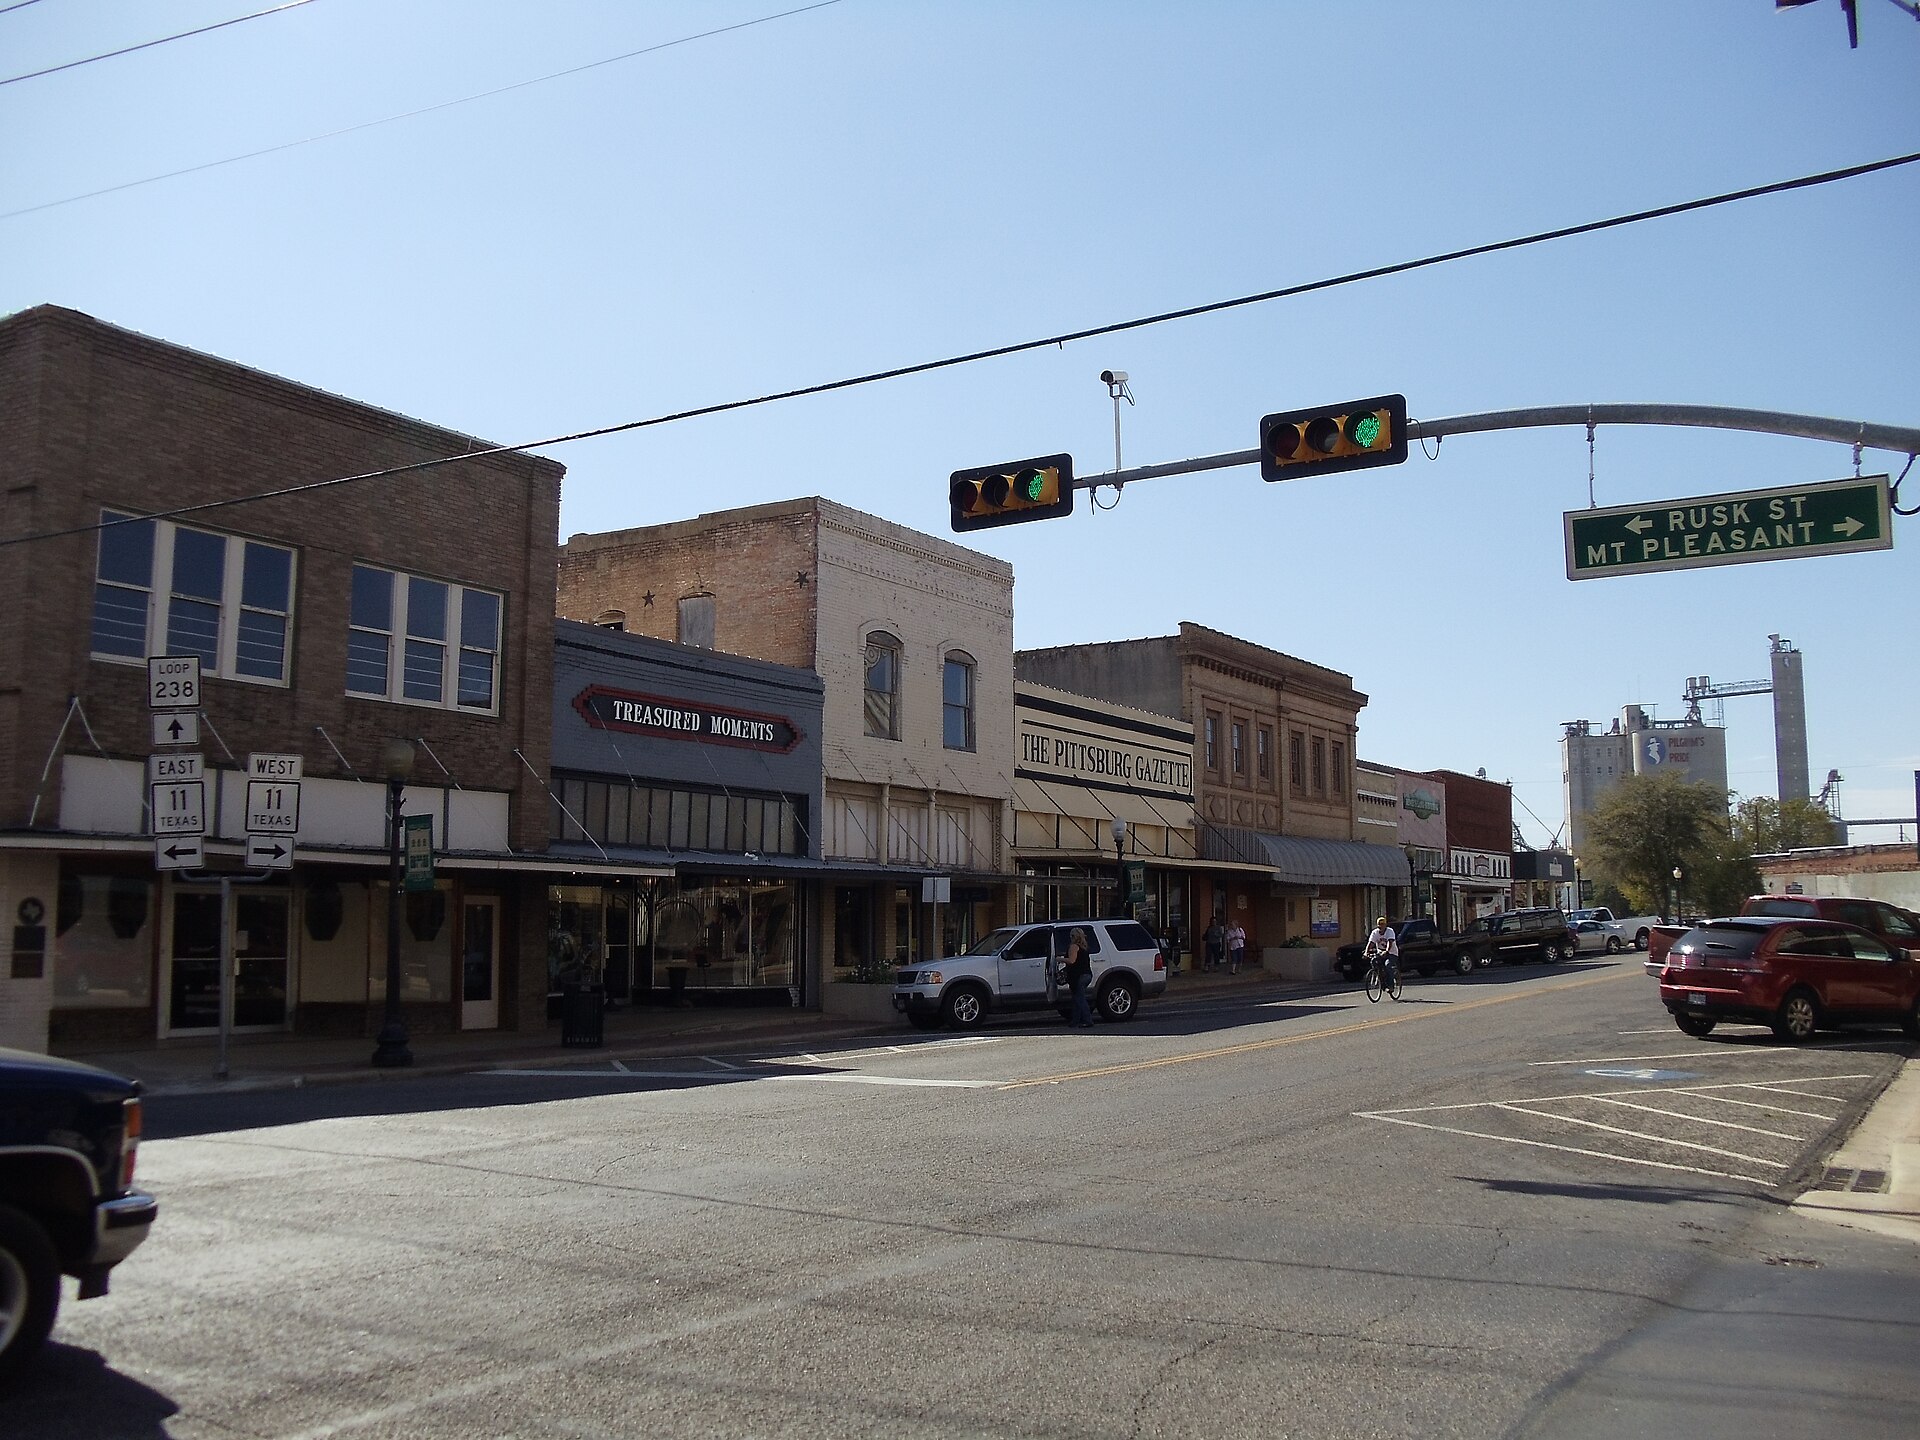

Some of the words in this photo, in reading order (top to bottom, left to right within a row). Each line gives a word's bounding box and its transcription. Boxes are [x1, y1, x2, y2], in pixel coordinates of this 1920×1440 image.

[1668, 502, 1751, 532] RUSK
[1768, 496, 1807, 520] ST
[1587, 541, 1626, 566] MT
[1642, 521, 1815, 560] PLEASANT
[158, 663, 190, 675] LOOP
[155, 681, 194, 698] 238
[613, 700, 700, 731] TREASURED
[710, 715, 774, 742] MOMENTS
[158, 759, 195, 775] EAST
[256, 759, 296, 775] WEST
[1021, 732, 1050, 765] THE
[1054, 738, 1132, 779] PITTSBURG
[1135, 755, 1189, 788] GAZETTE
[170, 789, 187, 811] 11
[266, 788, 282, 810] 11
[160, 816, 198, 827] TEXAS
[253, 814, 291, 826] TEXAS
